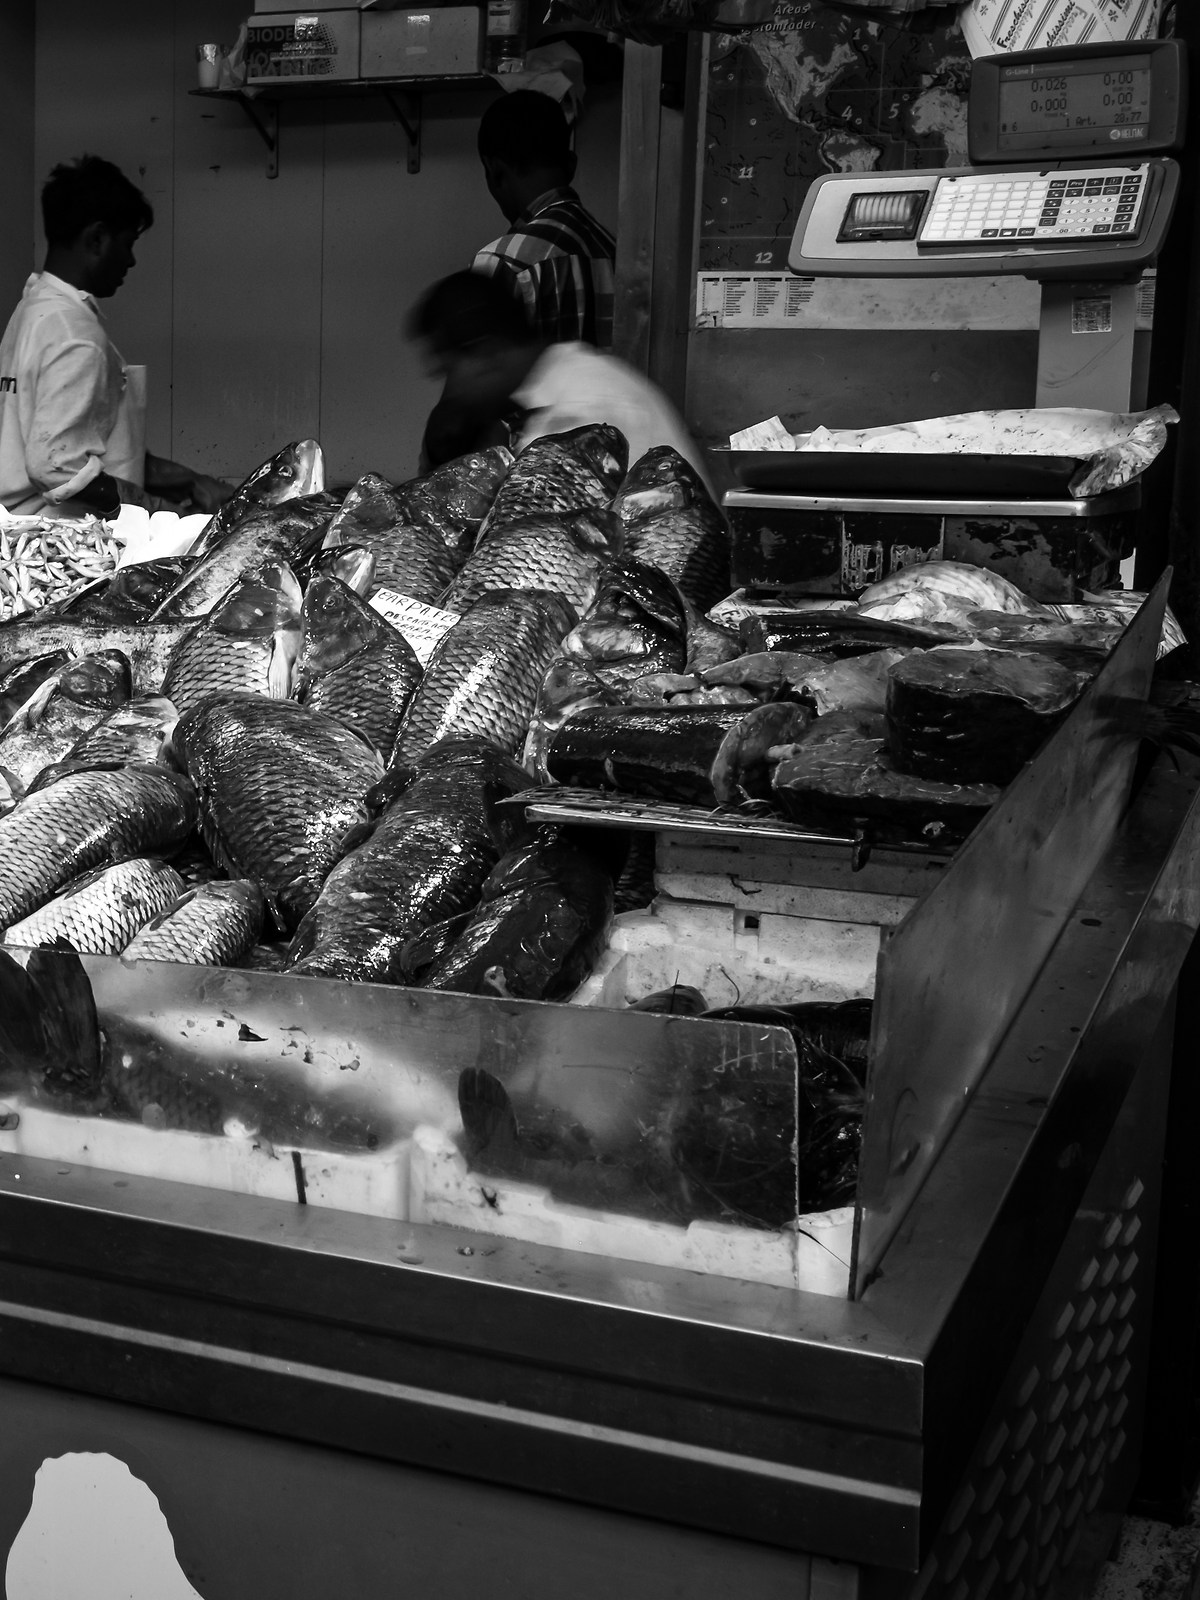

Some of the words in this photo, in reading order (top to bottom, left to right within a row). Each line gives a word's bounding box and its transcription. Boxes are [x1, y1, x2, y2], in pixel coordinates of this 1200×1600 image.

[1031, 77, 1068, 92] 0,026
[1104, 71, 1133, 86] 0,00
[1031, 97, 1067, 112] 0,000
[1103, 92, 1133, 106] 0,00
[841, 105, 854, 120] 4
[888, 103, 901, 118] 5
[738, 166, 754, 179] 11
[755, 252, 773, 264] 12
